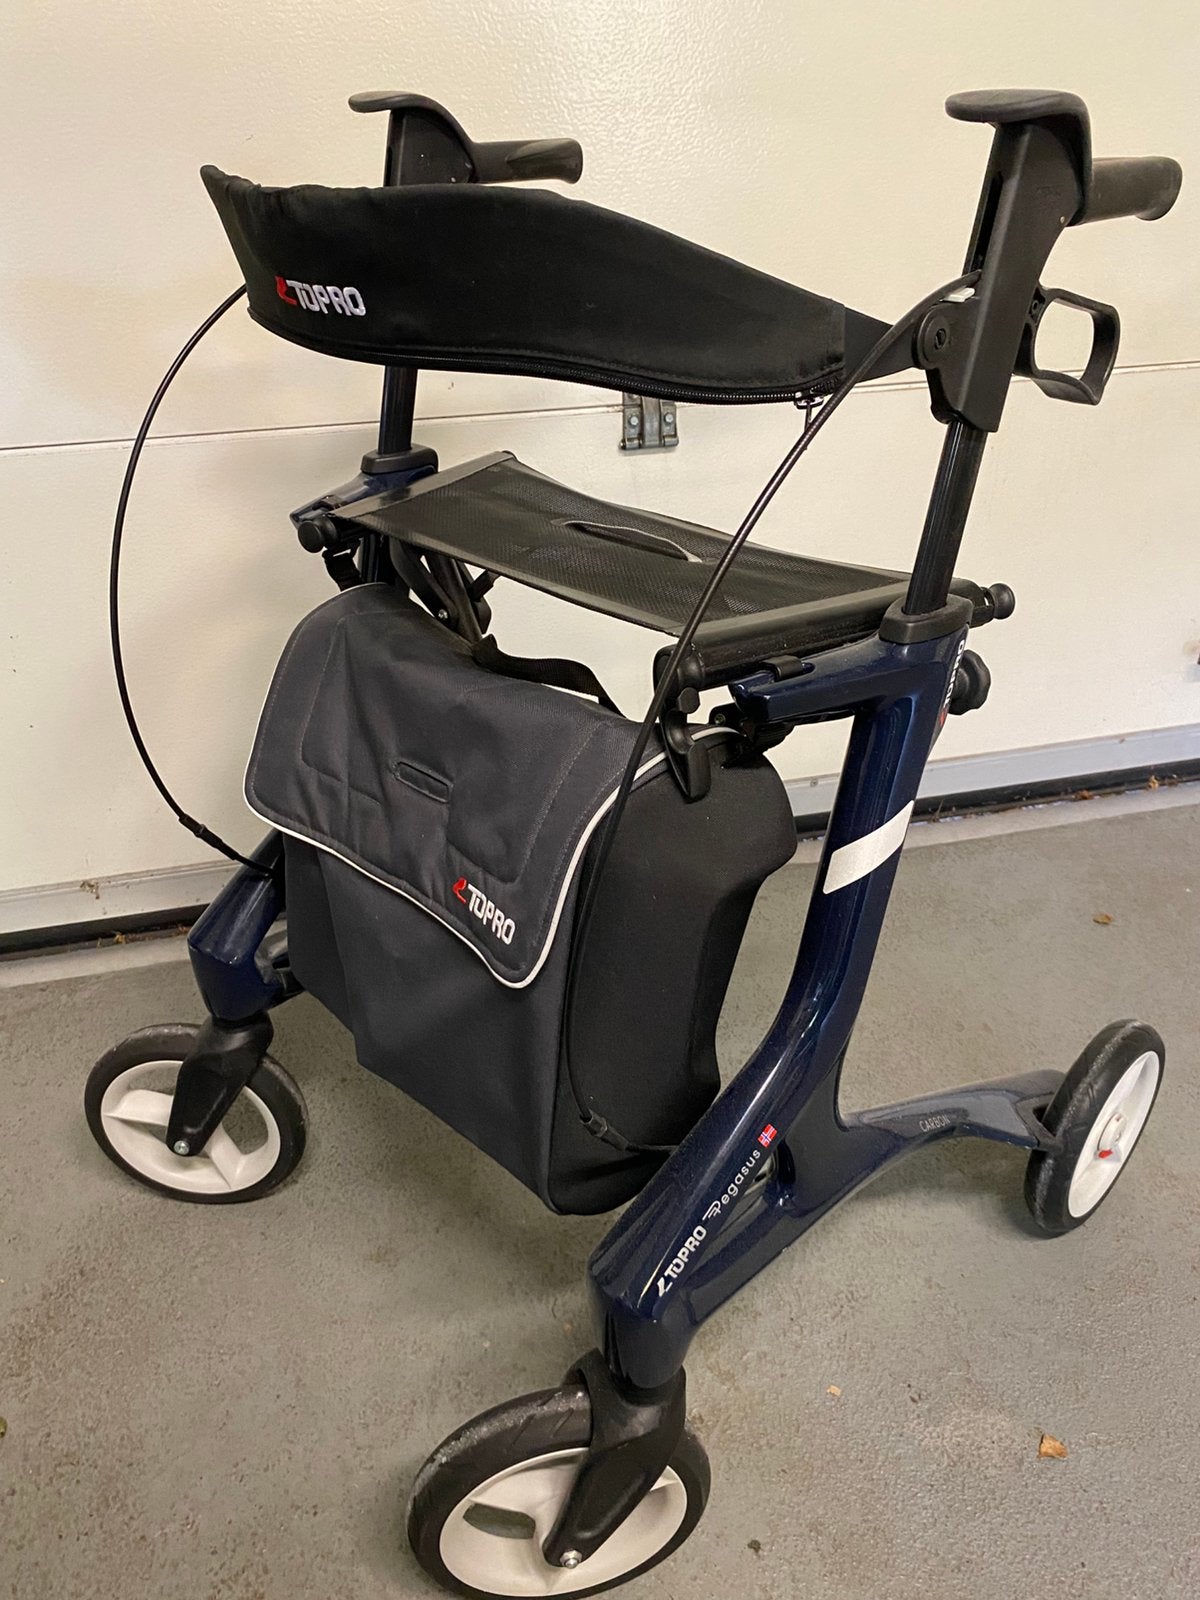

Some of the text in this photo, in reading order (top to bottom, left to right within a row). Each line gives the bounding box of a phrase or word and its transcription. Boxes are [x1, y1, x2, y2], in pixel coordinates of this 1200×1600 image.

[286, 279, 366, 316] TOPRO
[467, 883, 516, 945] TOPRO
[664, 1149, 761, 1279] TOPRO Pegasus
